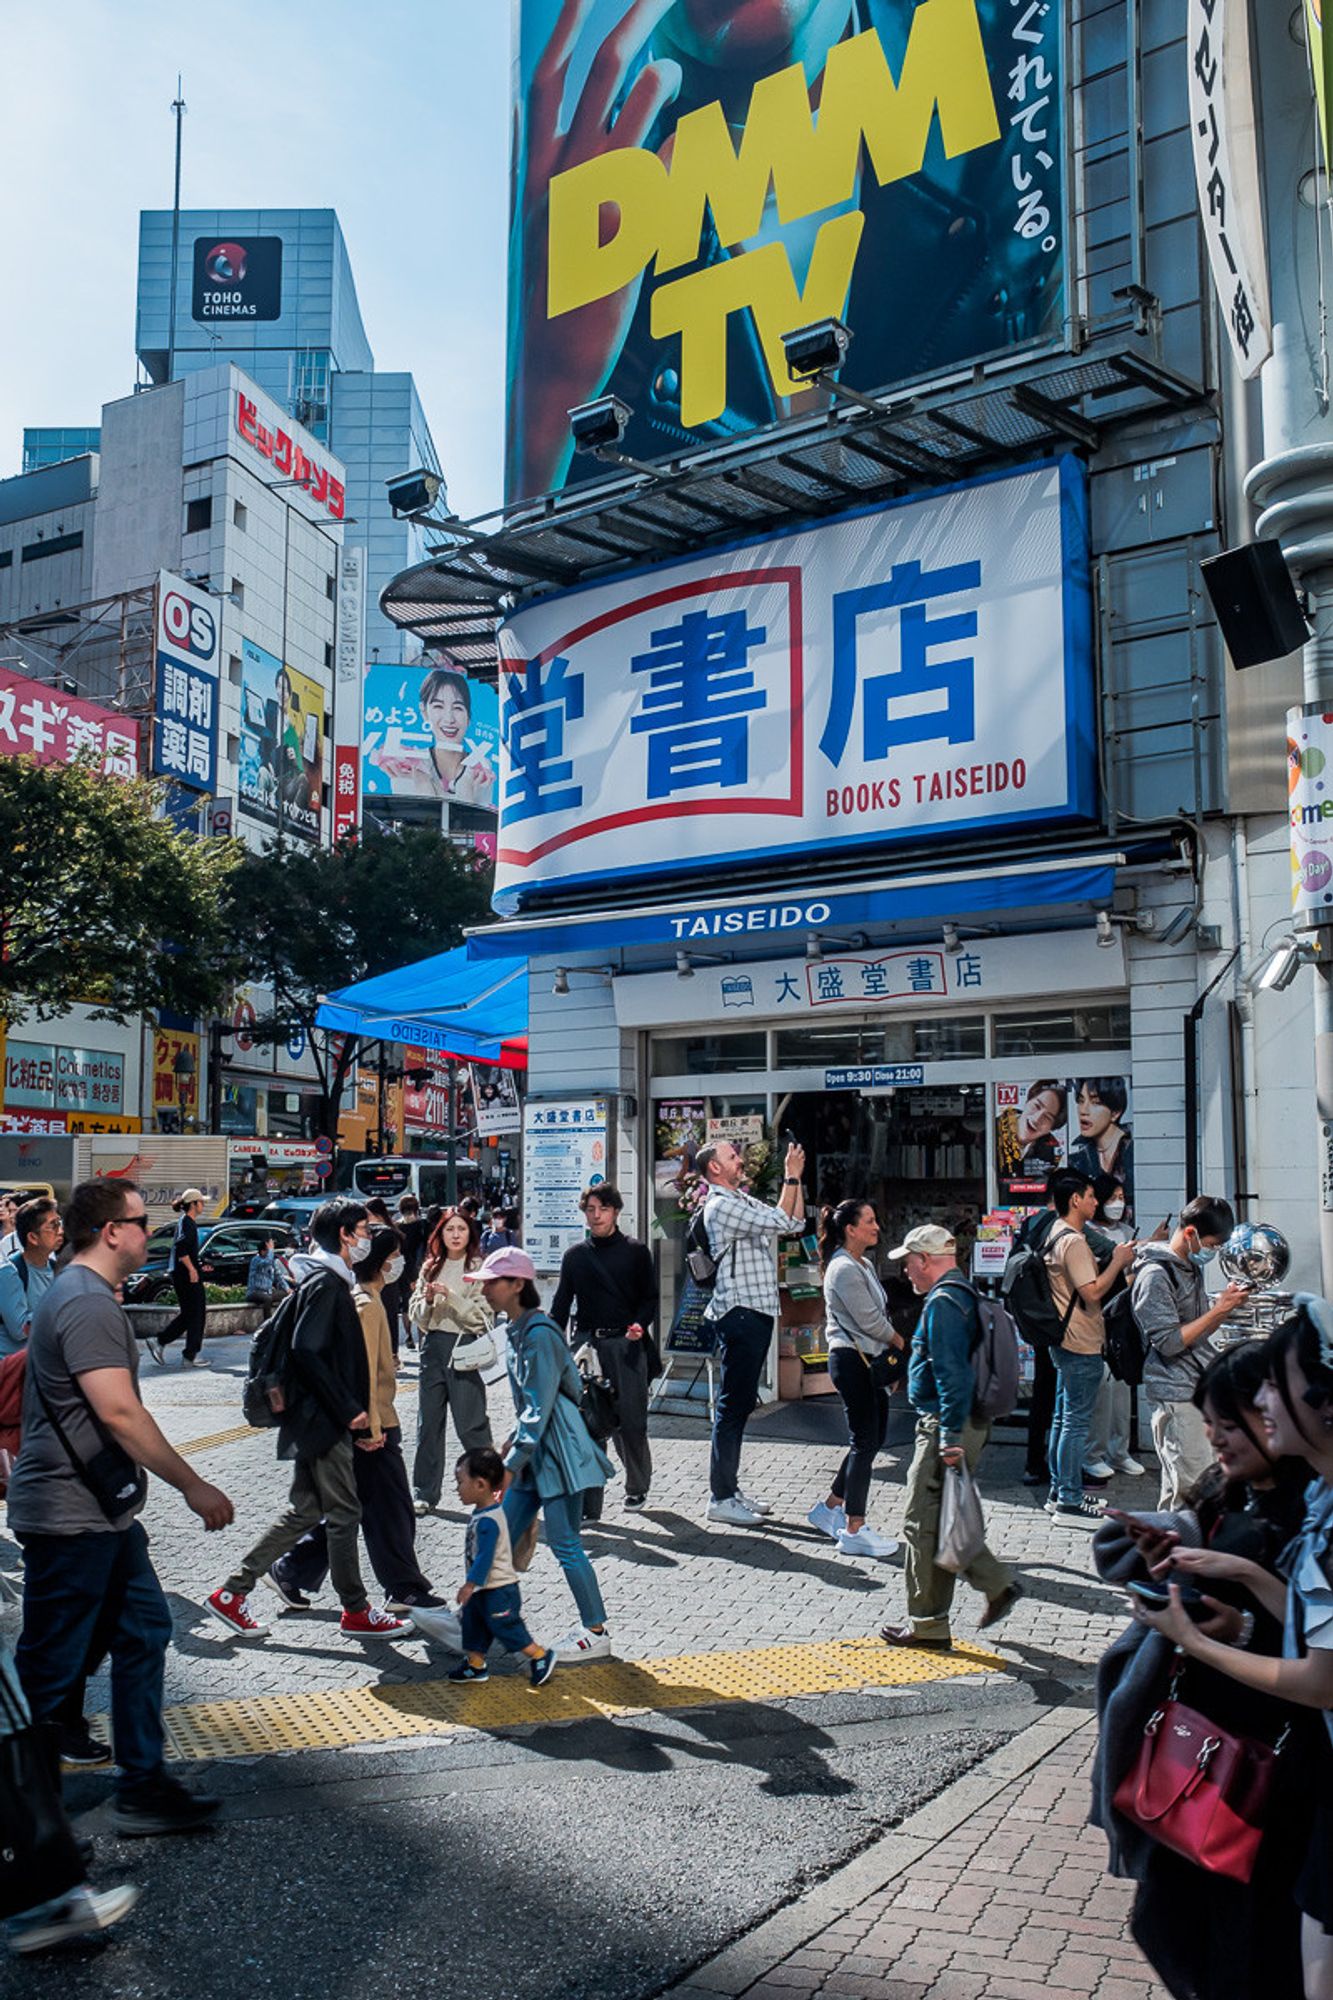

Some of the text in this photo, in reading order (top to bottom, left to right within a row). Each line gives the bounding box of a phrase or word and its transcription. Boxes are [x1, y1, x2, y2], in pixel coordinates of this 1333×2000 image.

[1007, 0, 1057, 253] ぐれている。
[548, 0, 1002, 320] DMM
[203, 291, 242, 304] TOHO
[203, 304, 257, 315] CINEMAS
[650, 209, 866, 429] TV
[238, 391, 345, 520] ビックカメラ
[164, 592, 214, 657] OS
[163, 663, 213, 729] 調剤
[501, 560, 982, 822] 堂書店
[161, 718, 210, 782] 薬局
[338, 762, 355, 796] 免税
[826, 758, 1027, 817] BOOKS TAISEIDO
[337, 810, 355, 841] Ta
[671, 902, 831, 938] TAISEIDO
[775, 953, 982, 1003] 大盛堂書店
[4, 1056, 54, 1092] 化粧品
[826, 1073, 845, 1085] Open
[846, 1070, 872, 1082] 9:30
[895, 1068, 922, 1080] 21:00
[999, 1087, 1017, 1099] TV
